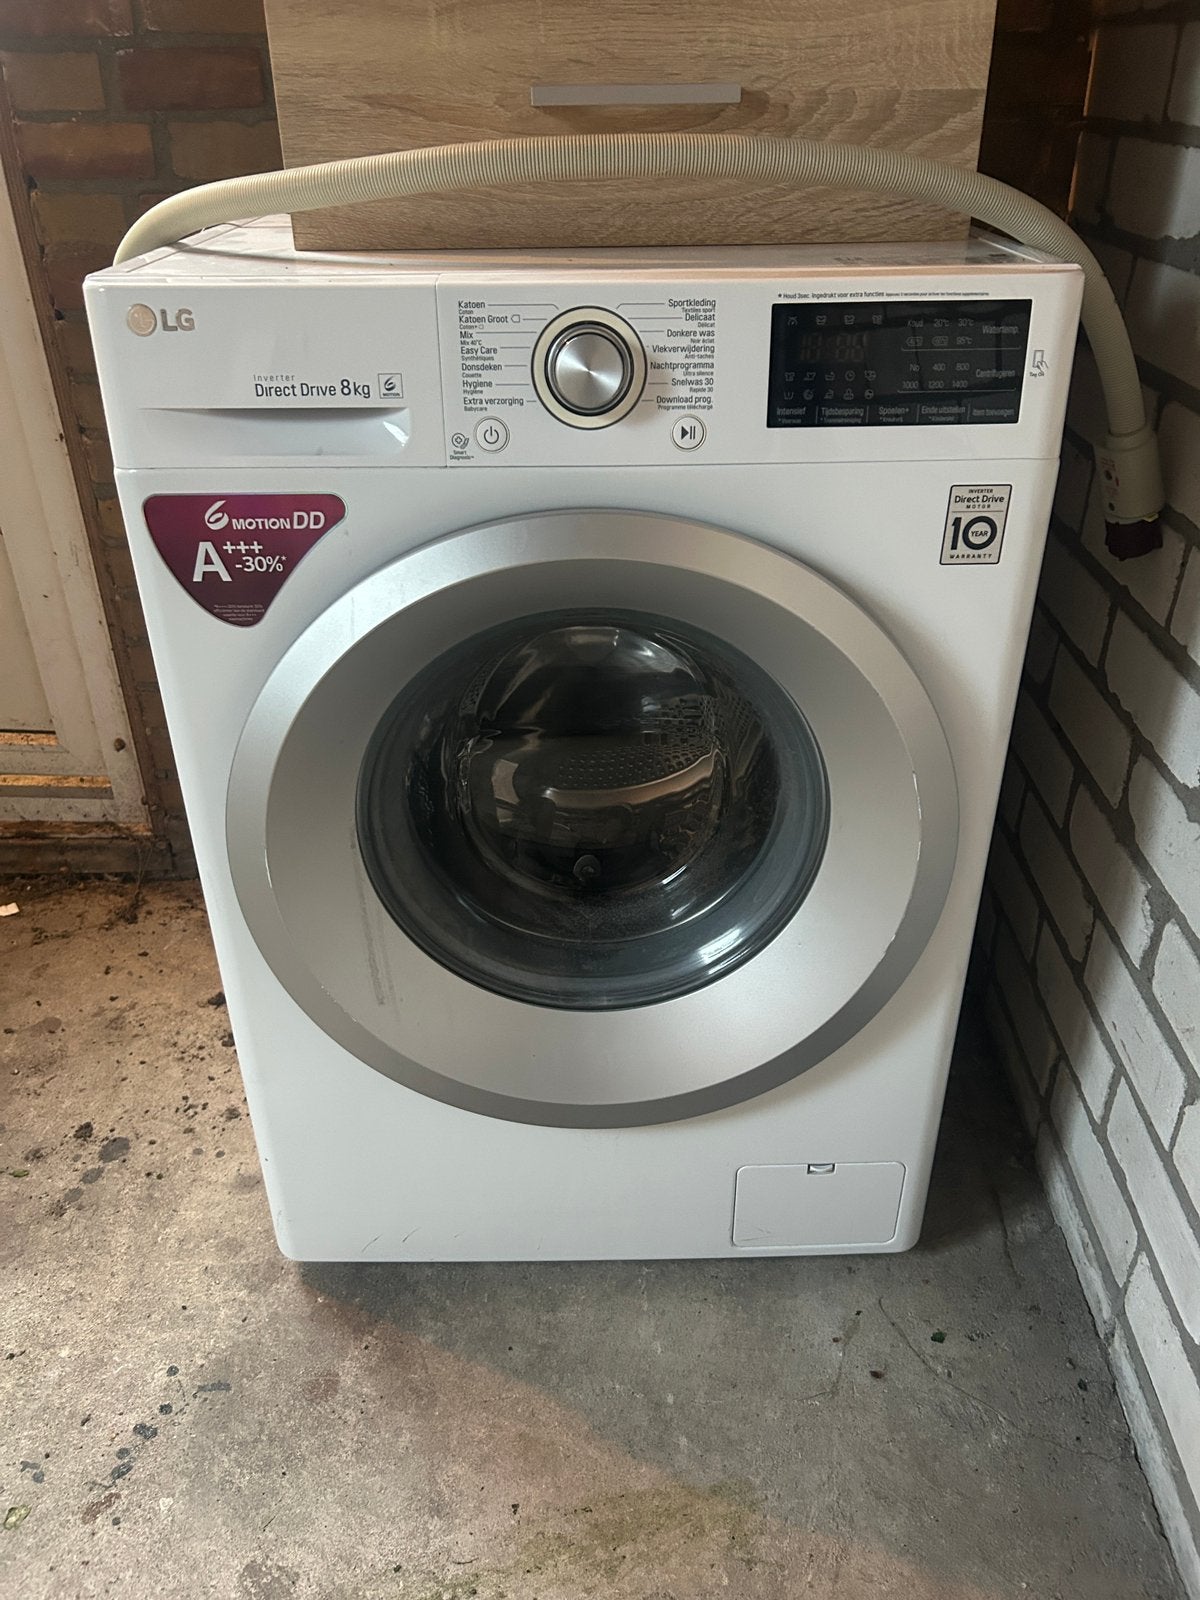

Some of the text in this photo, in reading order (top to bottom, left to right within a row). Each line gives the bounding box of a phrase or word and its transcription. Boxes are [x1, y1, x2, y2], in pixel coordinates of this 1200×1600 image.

[458, 300, 486, 309] Katoen
[668, 299, 716, 309] Sportkleding
[160, 308, 196, 332] LG
[458, 315, 509, 324] Katoen Groot
[685, 313, 716, 322] Delicaat
[459, 331, 474, 339] Mix
[666, 329, 698, 338] Donkere
[460, 347, 498, 356] Easy Care
[652, 345, 715, 354] Vlekverwijdering
[461, 363, 503, 372] Donsdeken
[650, 361, 715, 371] Nachtprogramma
[253, 374, 296, 382] Inverter
[671, 378, 714, 386] Snelwas 30
[254, 382, 298, 398] Direct
[300, 381, 337, 397] Drive
[463, 397, 524, 406] Extra verzorging
[656, 395, 694, 404] Download
[954, 494, 1005, 504] Direct Drive
[231, 517, 291, 531] MOTION
[292, 511, 326, 530] DD
[950, 515, 998, 551] 10
